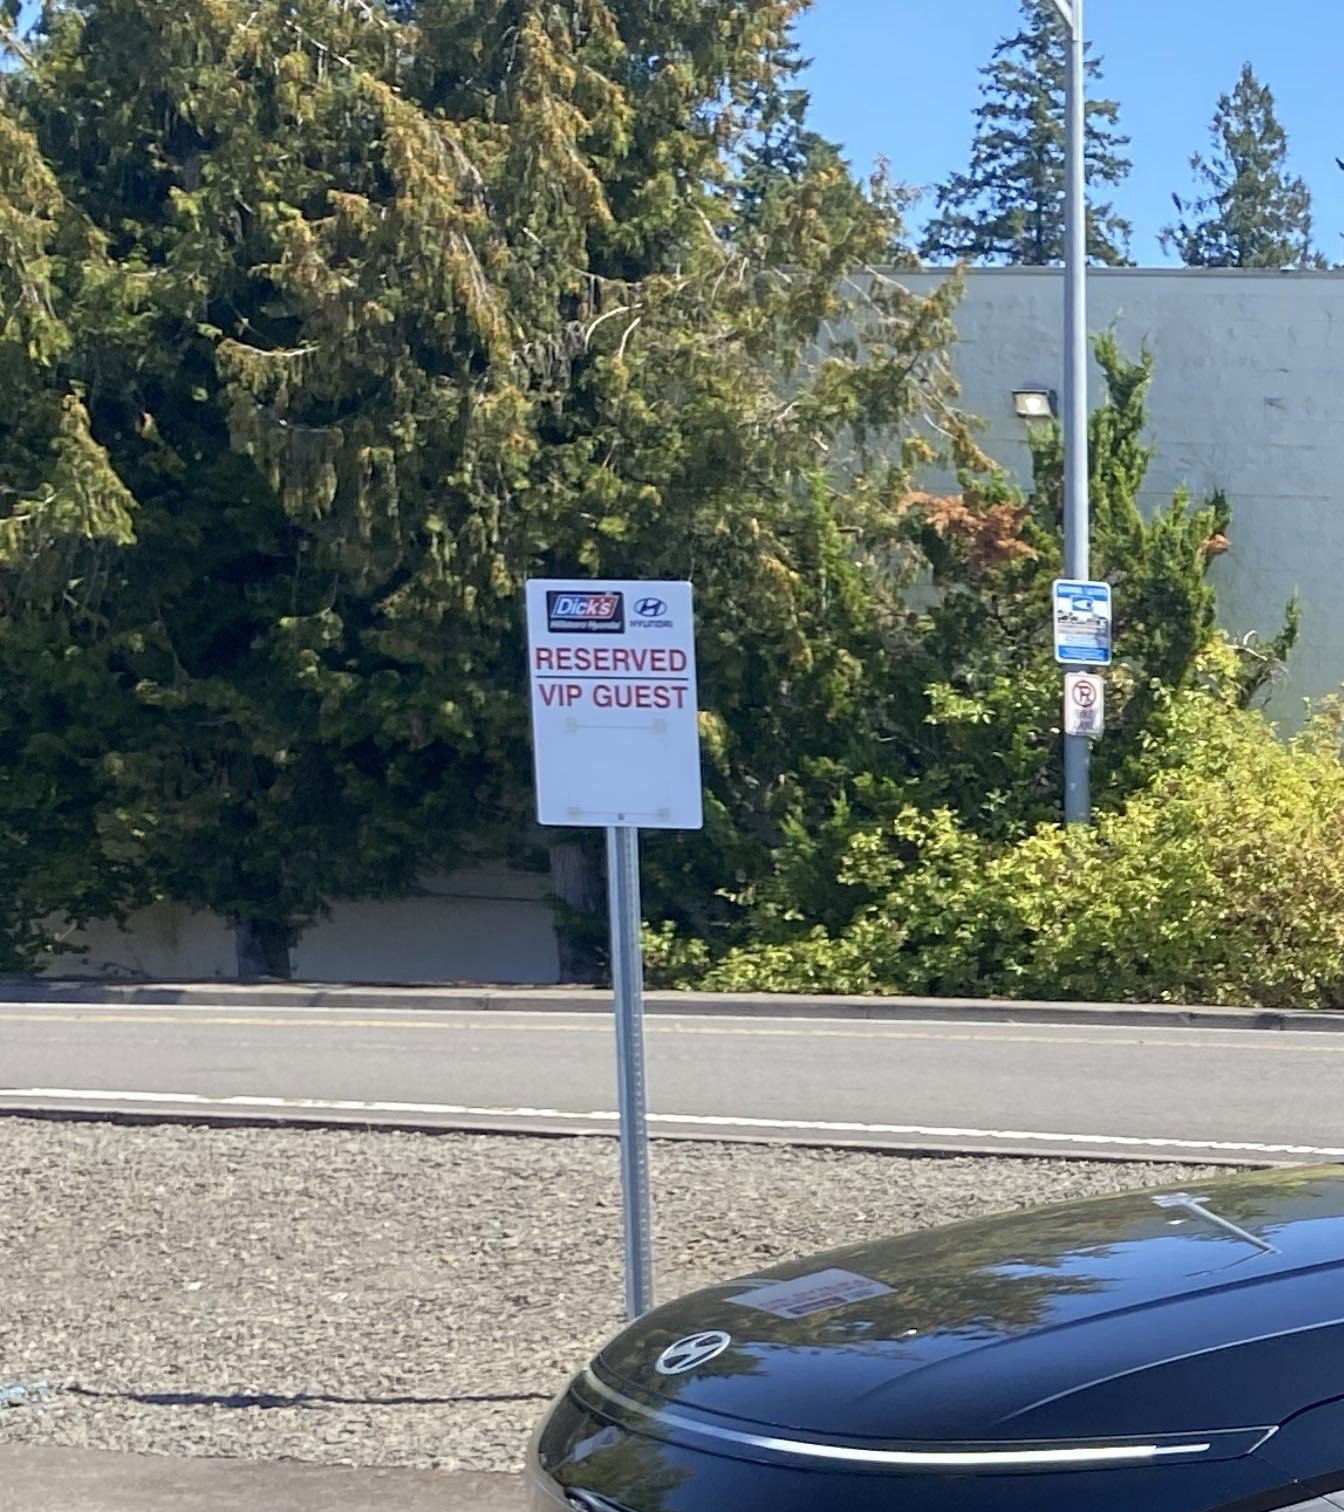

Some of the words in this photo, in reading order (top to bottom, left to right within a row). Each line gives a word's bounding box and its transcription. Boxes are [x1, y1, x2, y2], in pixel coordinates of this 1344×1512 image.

[557, 598, 612, 616] Dick's
[535, 647, 687, 671] RESERVED
[538, 684, 582, 706] VIP
[592, 685, 688, 708] GUEST
